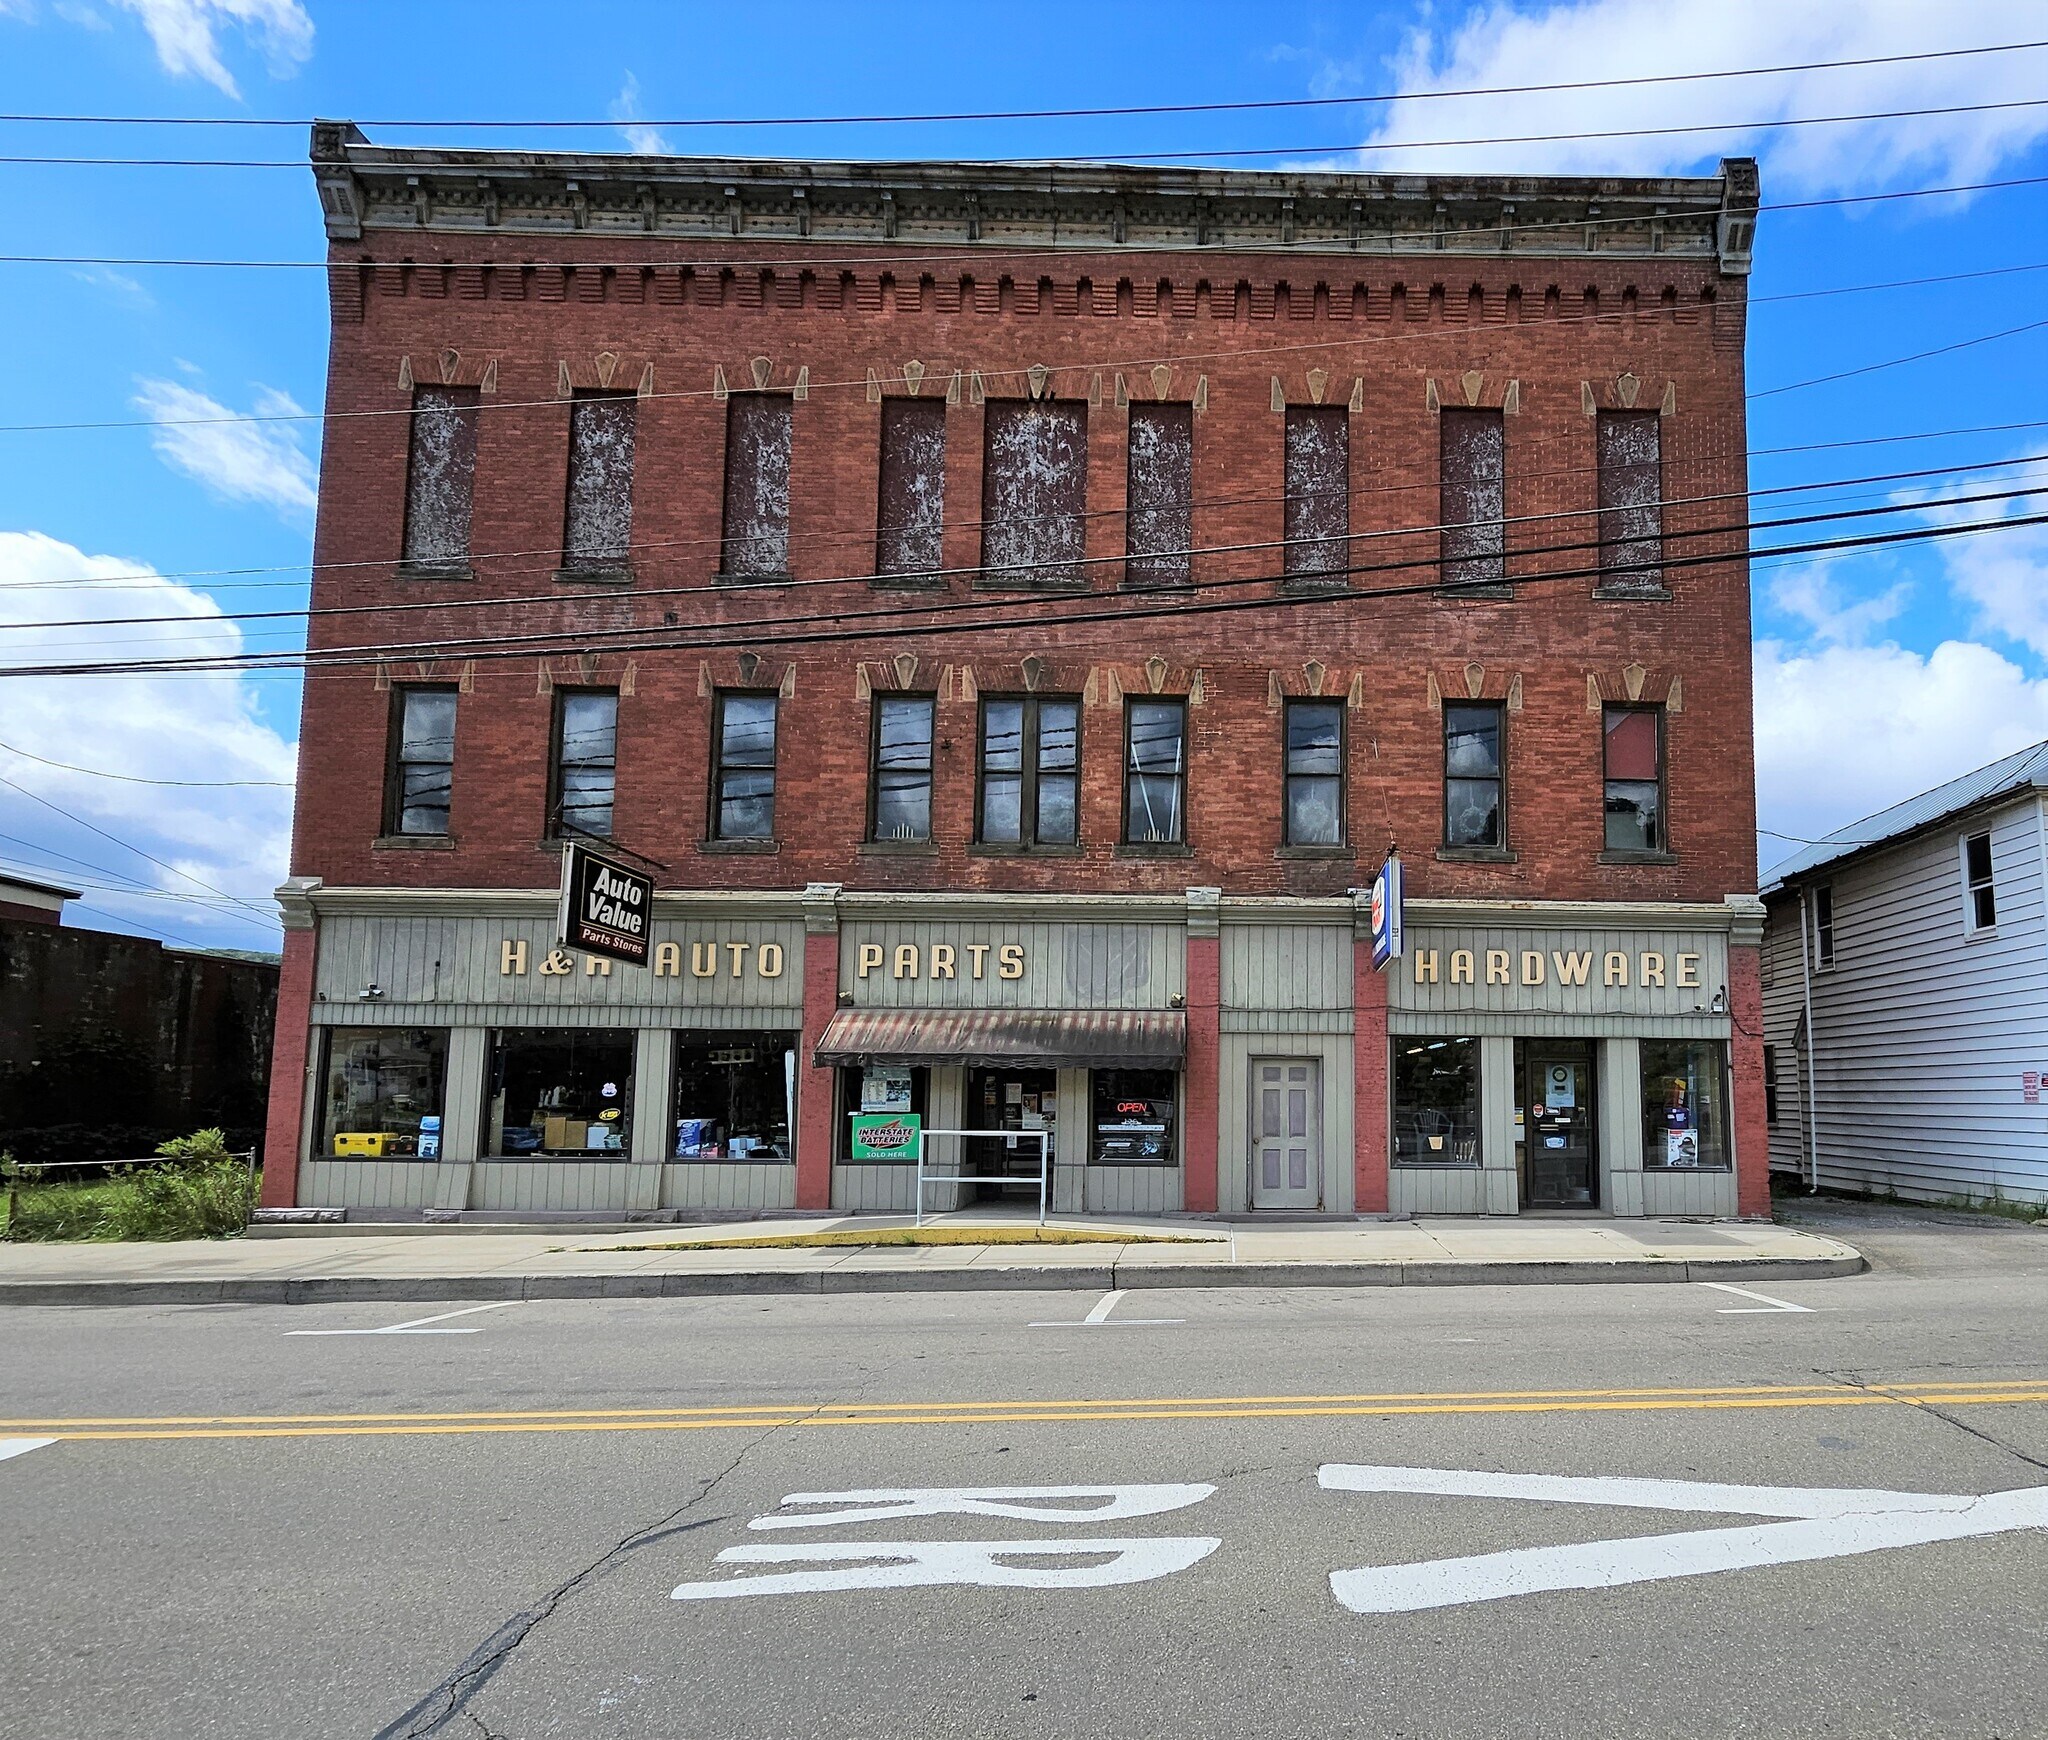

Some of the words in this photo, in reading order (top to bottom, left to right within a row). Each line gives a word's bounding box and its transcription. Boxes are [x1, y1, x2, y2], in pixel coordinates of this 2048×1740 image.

[593, 867, 642, 905] Auto
[589, 892, 642, 933] Value
[582, 928, 611, 945] Parts
[612, 936, 643, 954] Stores
[501, 940, 526, 975] H
[538, 950, 572, 975] &
[655, 942, 783, 977] AUTO
[859, 944, 1024, 978] PARTS
[1415, 949, 1700, 987] HARDWARE
[1117, 1102, 1147, 1113] OPEN
[858, 1127, 914, 1136] INTERSTATE
[860, 1135, 910, 1144] BATTERIES
